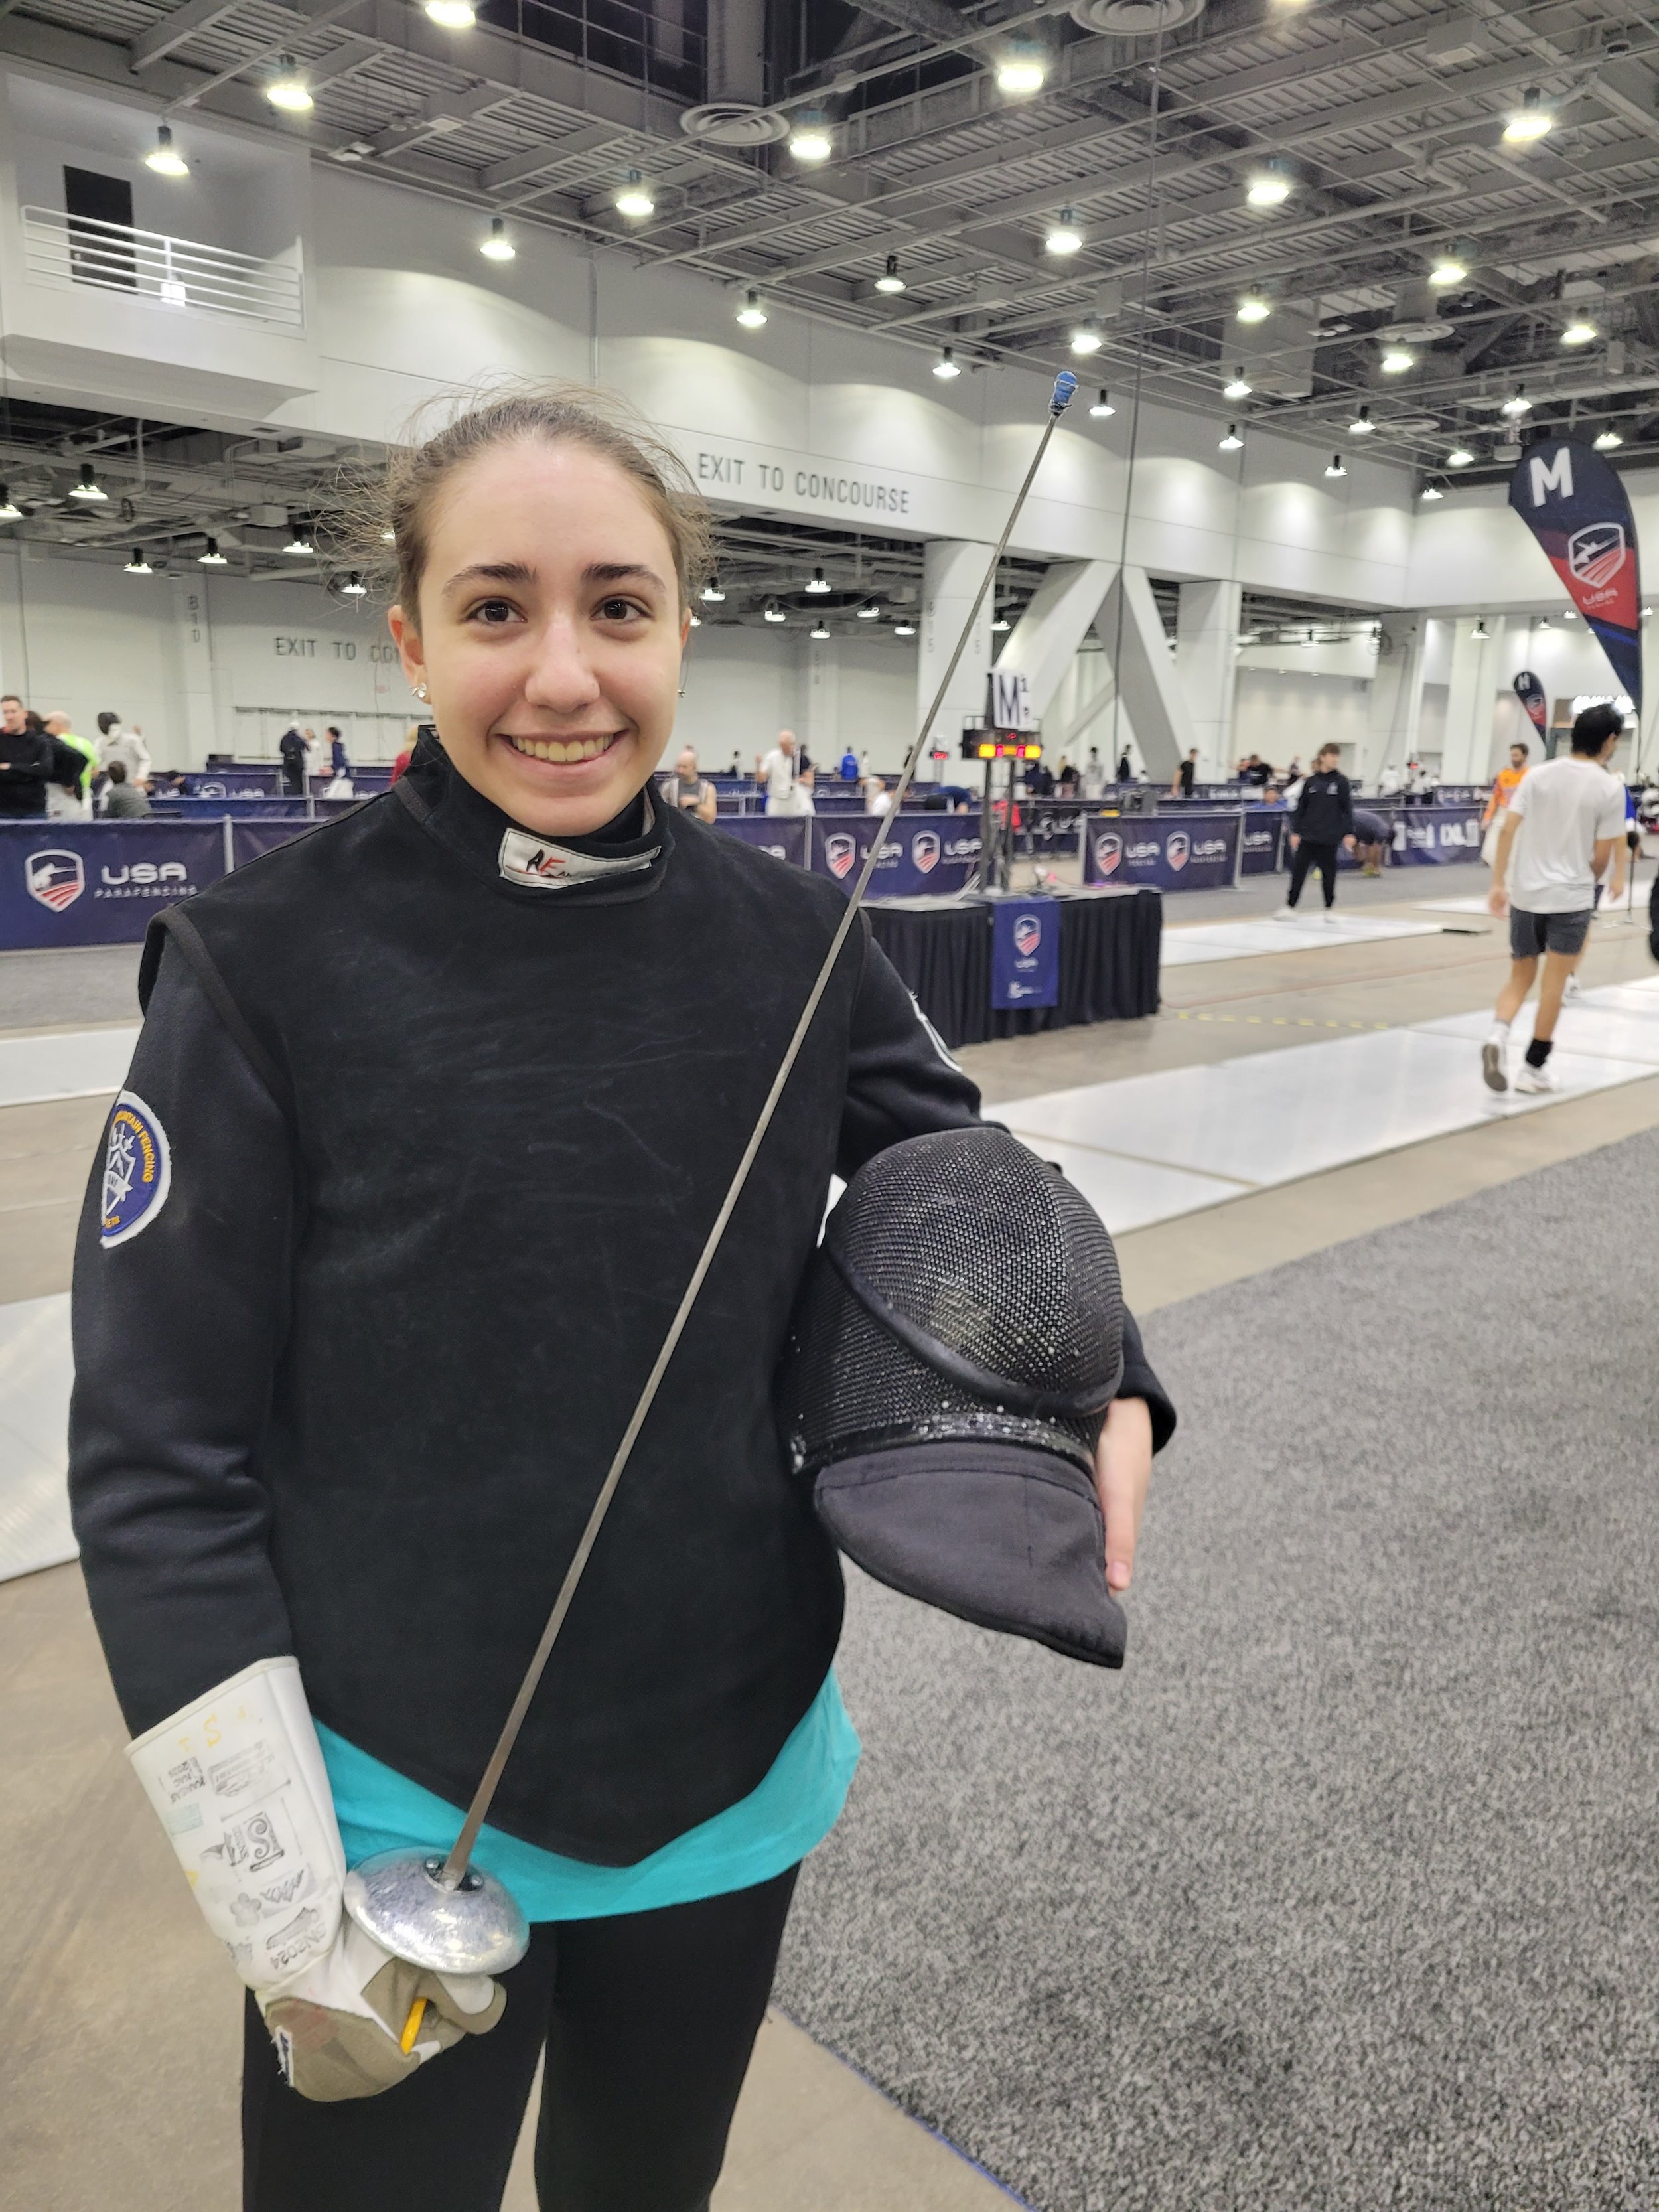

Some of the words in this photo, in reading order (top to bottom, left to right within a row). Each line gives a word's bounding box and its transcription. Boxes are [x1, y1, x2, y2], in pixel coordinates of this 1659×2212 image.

[699, 453, 745, 486] EXIT
[759, 464, 784, 492] TO
[796, 471, 909, 514] CONCOURSE
[1530, 447, 1573, 508] M
[275, 637, 318, 658] EXIT
[330, 641, 357, 661] TO
[999, 674, 1019, 726] M
[1126, 842, 1161, 859] USA
[1193, 839, 1226, 855] USA
[101, 861, 188, 885] USA
[137, 1130, 155, 1183] FENCING
